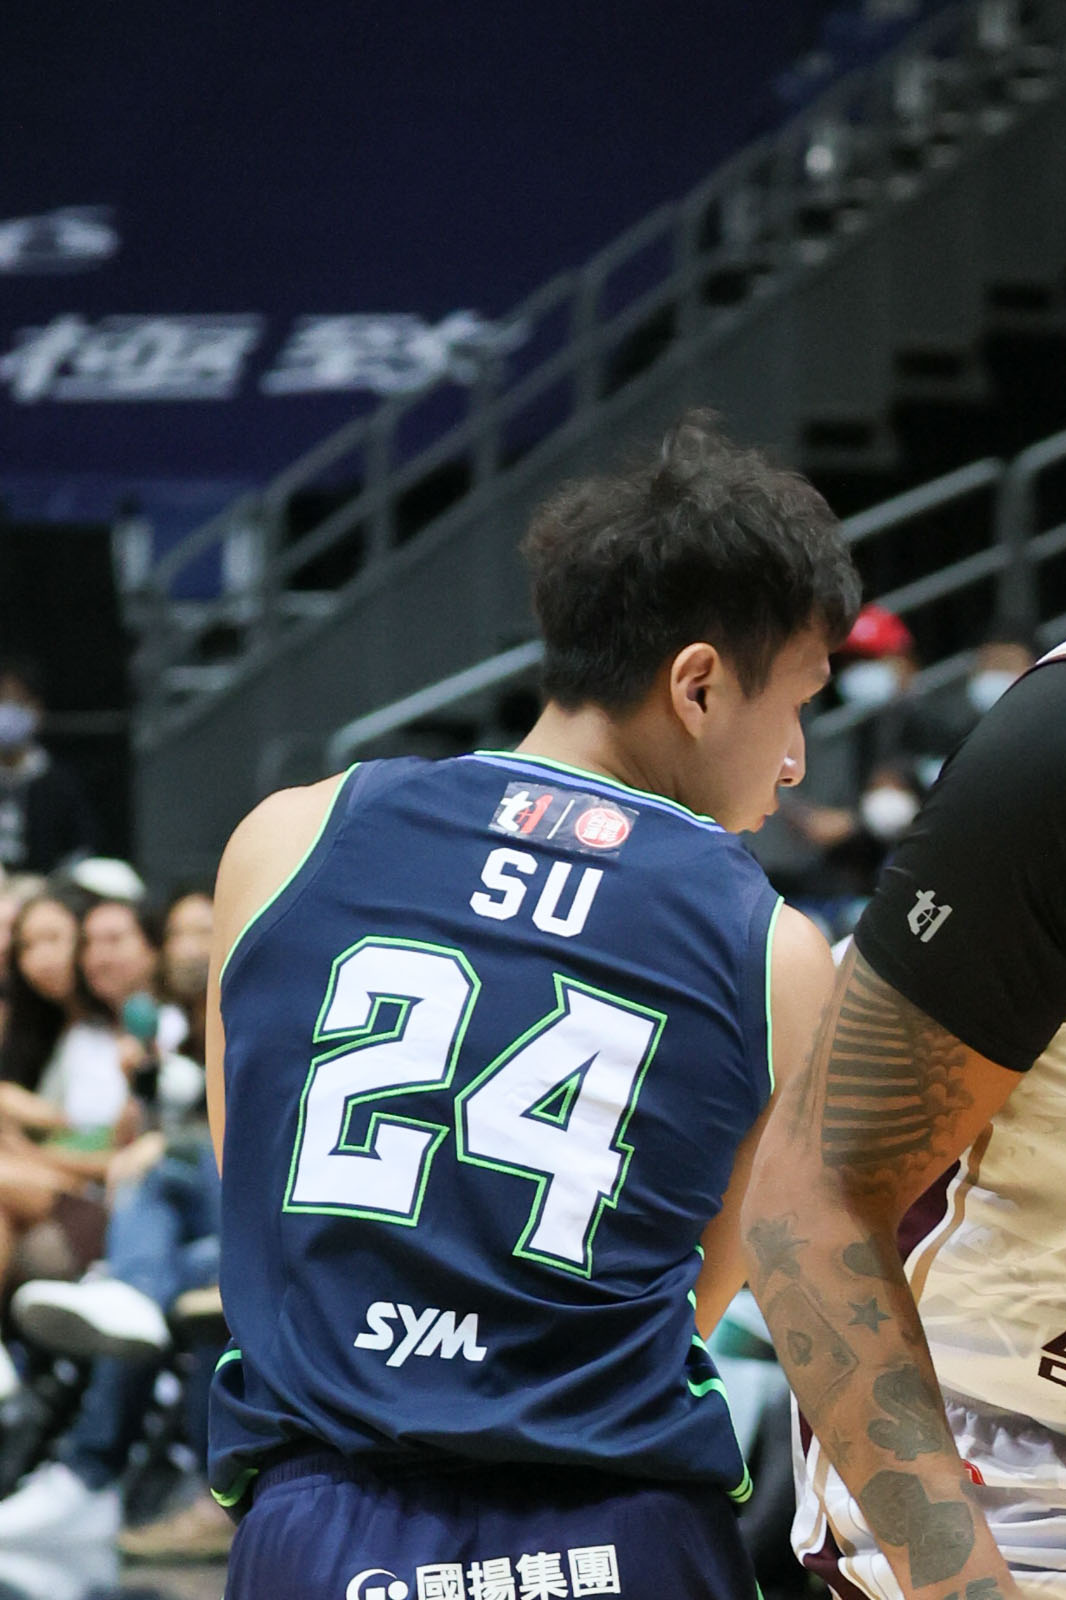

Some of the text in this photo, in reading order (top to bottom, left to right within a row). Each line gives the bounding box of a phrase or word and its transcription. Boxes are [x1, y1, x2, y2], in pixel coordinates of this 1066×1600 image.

[469, 847, 603, 938] SU
[283, 935, 669, 1279] 24
[353, 1301, 488, 1369] SYM
